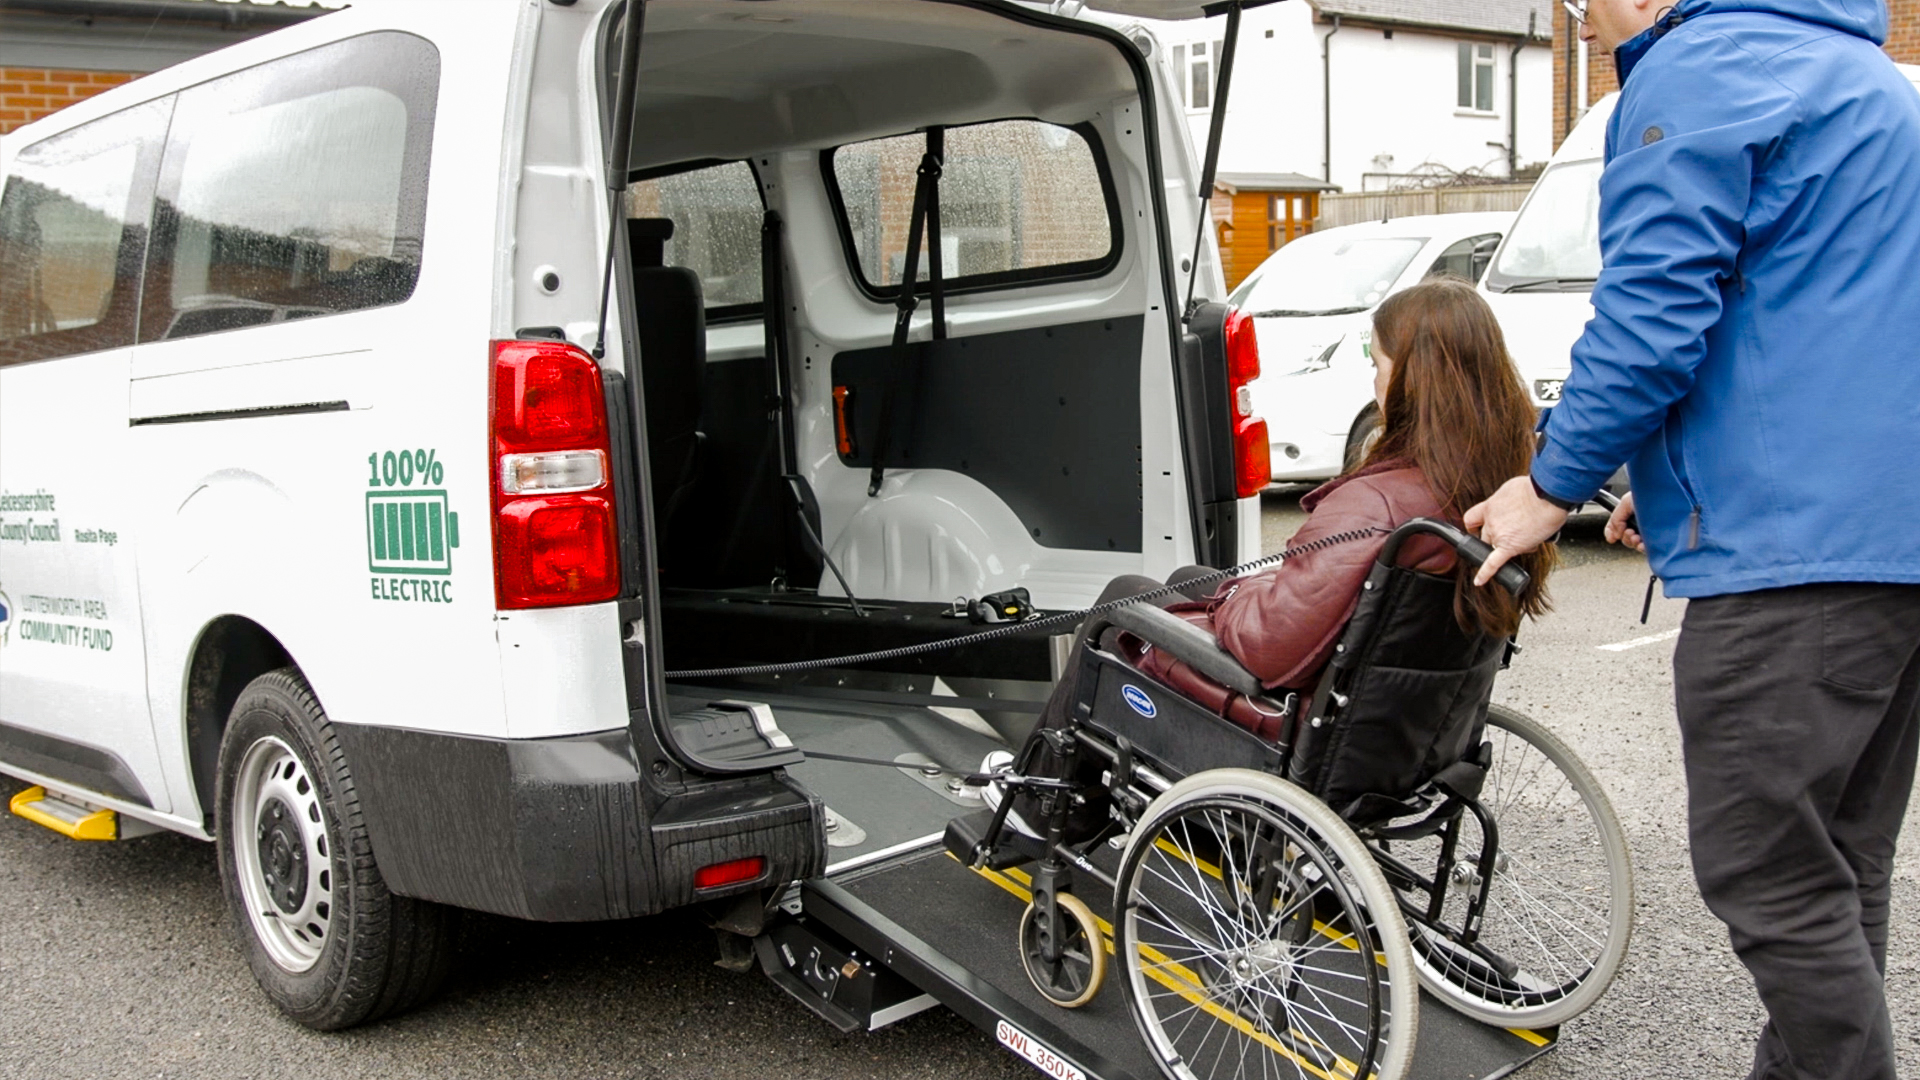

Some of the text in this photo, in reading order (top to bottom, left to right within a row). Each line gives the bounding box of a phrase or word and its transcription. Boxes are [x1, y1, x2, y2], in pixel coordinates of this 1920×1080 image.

[368, 449, 444, 487] 100%
[0, 488, 55, 511] eicestershire
[27, 518, 60, 541] Council
[98, 529, 118, 546] Page
[371, 578, 453, 603] ELECTRIC
[21, 595, 108, 620] LUTTERWORTH AREA
[20, 619, 113, 651] COMMUNITY FUND
[1075, 856, 1093, 871] Duo
[999, 1023, 1032, 1057] SWL
[1036, 1048, 1065, 1077] 350
